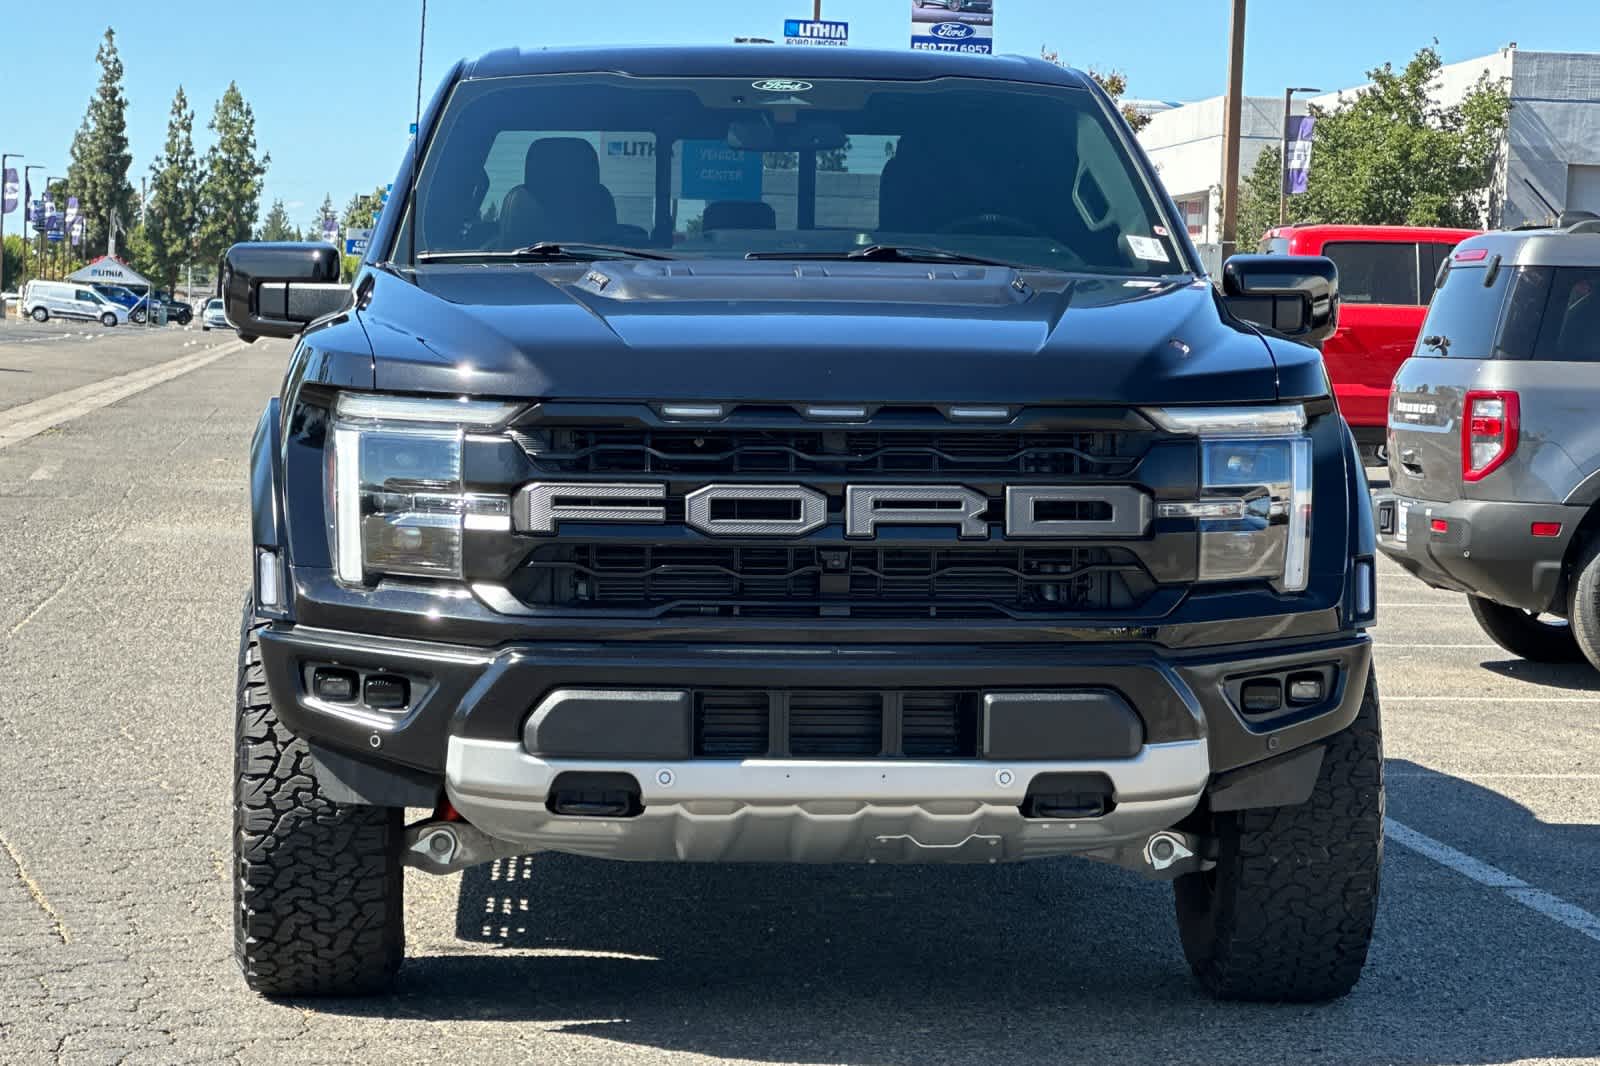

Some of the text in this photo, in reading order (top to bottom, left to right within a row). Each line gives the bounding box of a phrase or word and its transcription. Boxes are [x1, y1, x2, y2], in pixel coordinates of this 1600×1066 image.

[799, 23, 847, 38] LITHIA
[938, 24, 967, 37] Ford
[512, 481, 1154, 539] FORD
